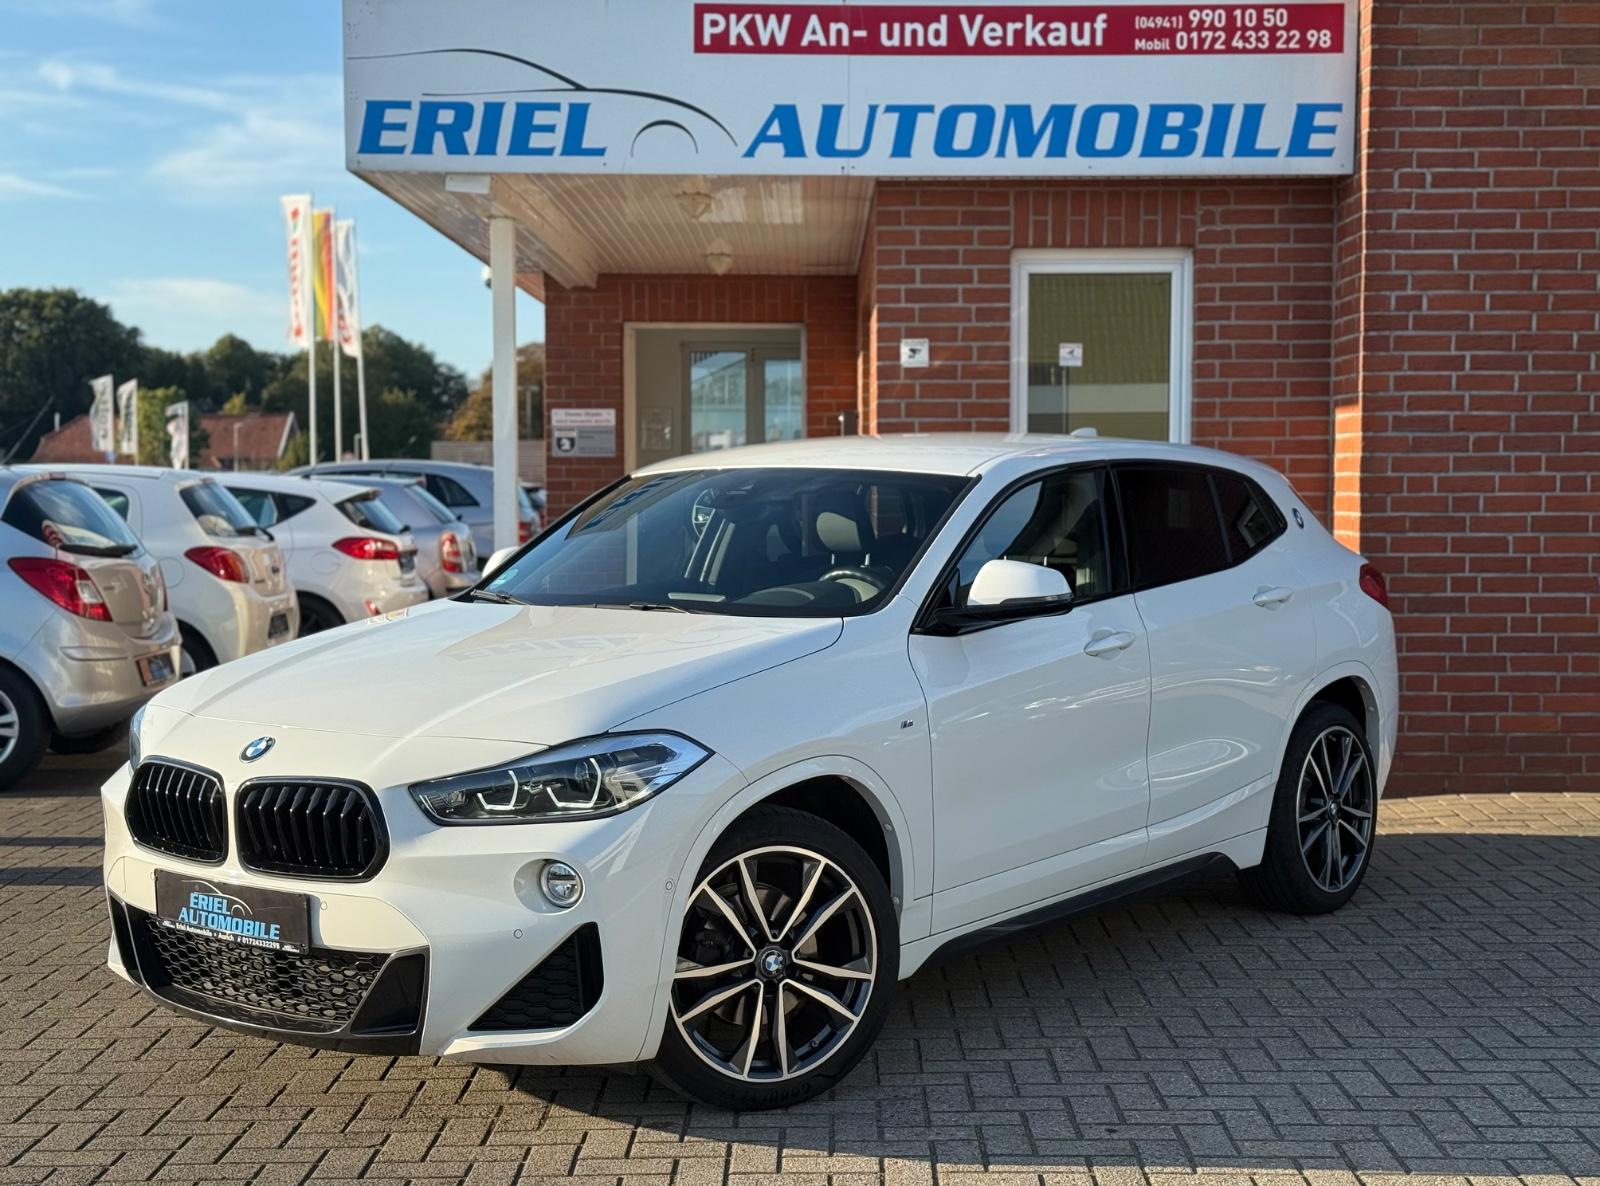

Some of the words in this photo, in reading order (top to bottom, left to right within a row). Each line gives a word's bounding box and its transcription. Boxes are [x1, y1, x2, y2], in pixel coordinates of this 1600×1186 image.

[702, 12, 792, 47] PKW
[799, 13, 868, 47] An-
[879, 14, 948, 47] und
[958, 12, 1108, 47] Verkauf
[1134, 15, 1183, 30] (04941)
[1188, 8, 1226, 28] 990
[1233, 8, 1257, 28] 10
[1263, 7, 1288, 27] 50
[1134, 38, 1170, 51] Mobil
[1175, 31, 1226, 50] 0172
[1231, 30, 1270, 49] 433
[1275, 29, 1301, 49] 22
[1306, 29, 1332, 48] 98
[357, 100, 607, 157] ERIEL
[741, 103, 1344, 159] AUTOMOBILE
[189, 892, 231, 915] ERIEL
[178, 906, 281, 940] AUTOMOBILE
